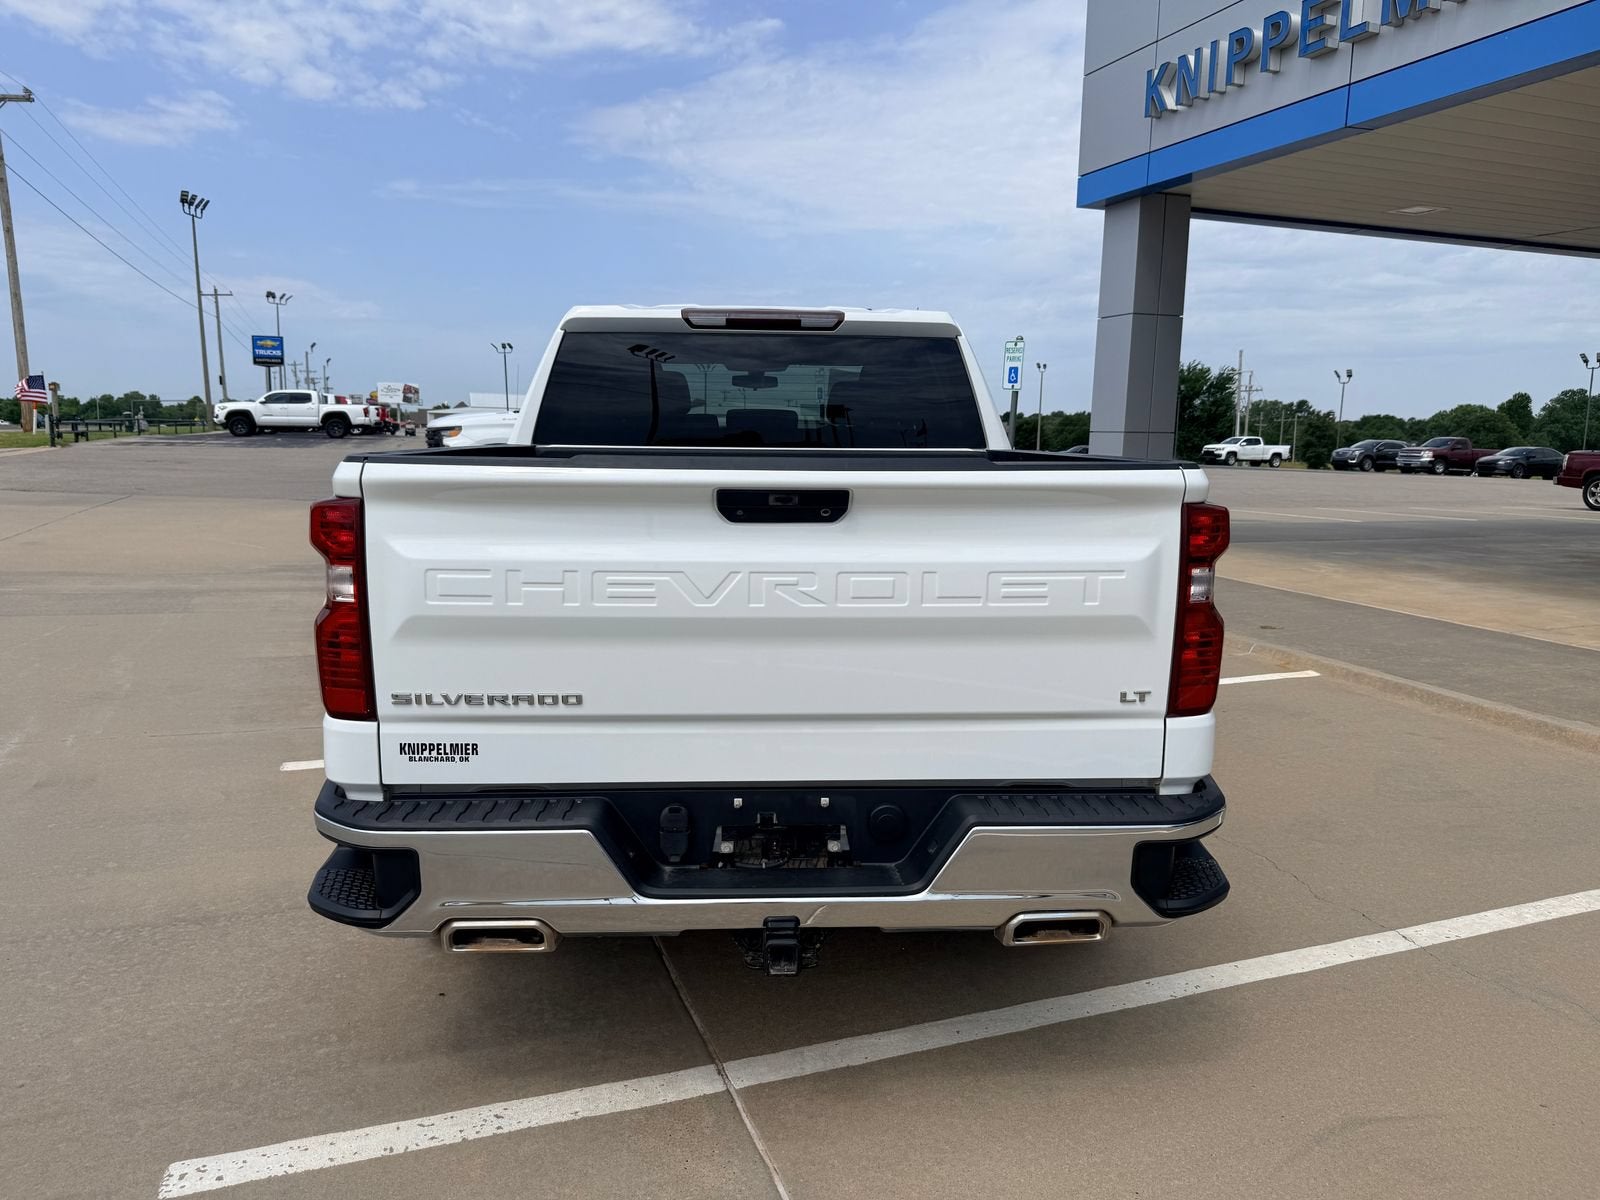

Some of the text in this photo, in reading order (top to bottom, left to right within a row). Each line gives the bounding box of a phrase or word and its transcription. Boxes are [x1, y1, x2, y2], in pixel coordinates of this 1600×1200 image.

[424, 568, 1127, 607] CHEVROLET
[391, 693, 584, 706] SILVERADO
[1120, 691, 1151, 702] LT
[399, 742, 479, 756] KNIPPELMIER
[408, 755, 470, 764] BLANCHARD, OK
